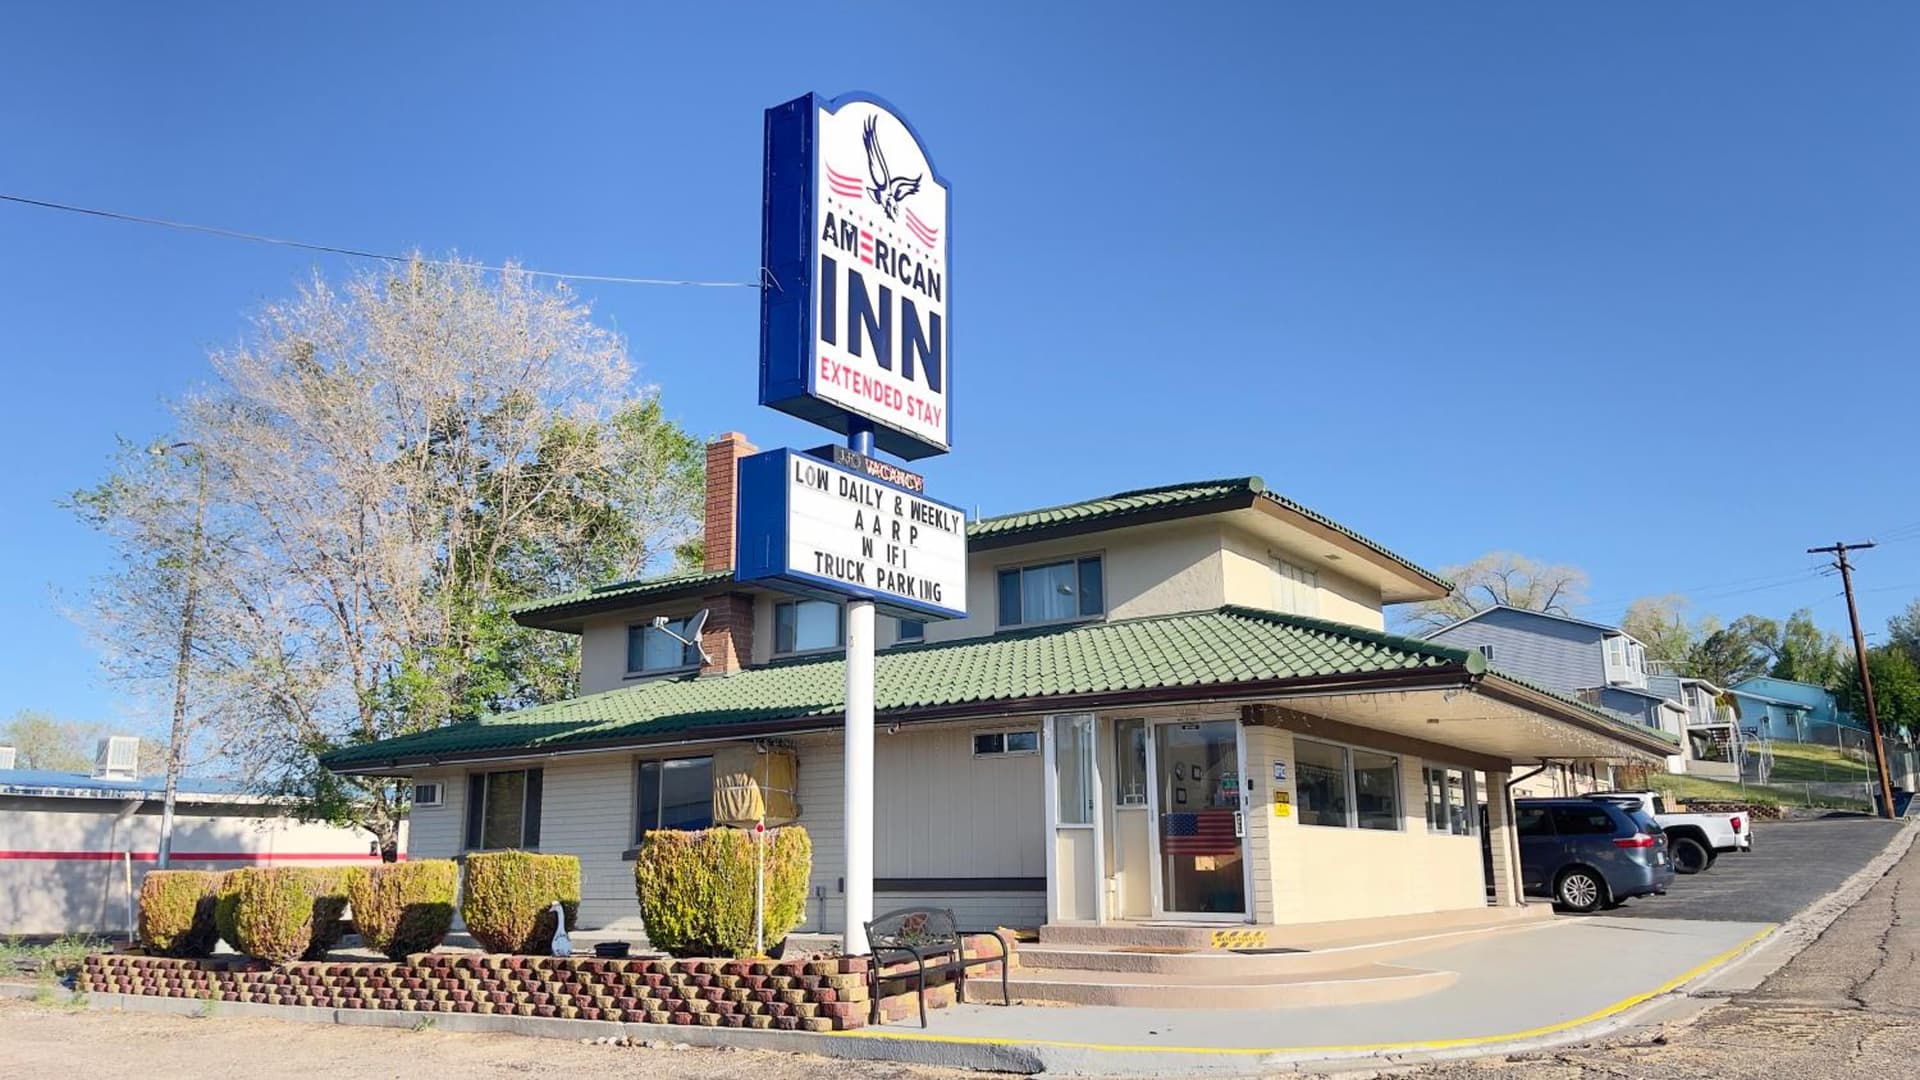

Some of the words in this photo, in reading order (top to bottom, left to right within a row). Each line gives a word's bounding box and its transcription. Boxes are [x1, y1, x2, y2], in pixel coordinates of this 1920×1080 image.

[822, 212, 941, 303] AMERICAN
[821, 254, 941, 394] INN
[821, 357, 902, 412] EXTENDED
[907, 395, 942, 428] STAY
[795, 461, 829, 492] LOW
[839, 476, 883, 509] DAILY
[894, 495, 903, 517] &
[911, 500, 959, 535] WEEKLY
[865, 458, 923, 491] VACANCY
[814, 551, 865, 583] TRUCK
[877, 568, 942, 602] PARKING
